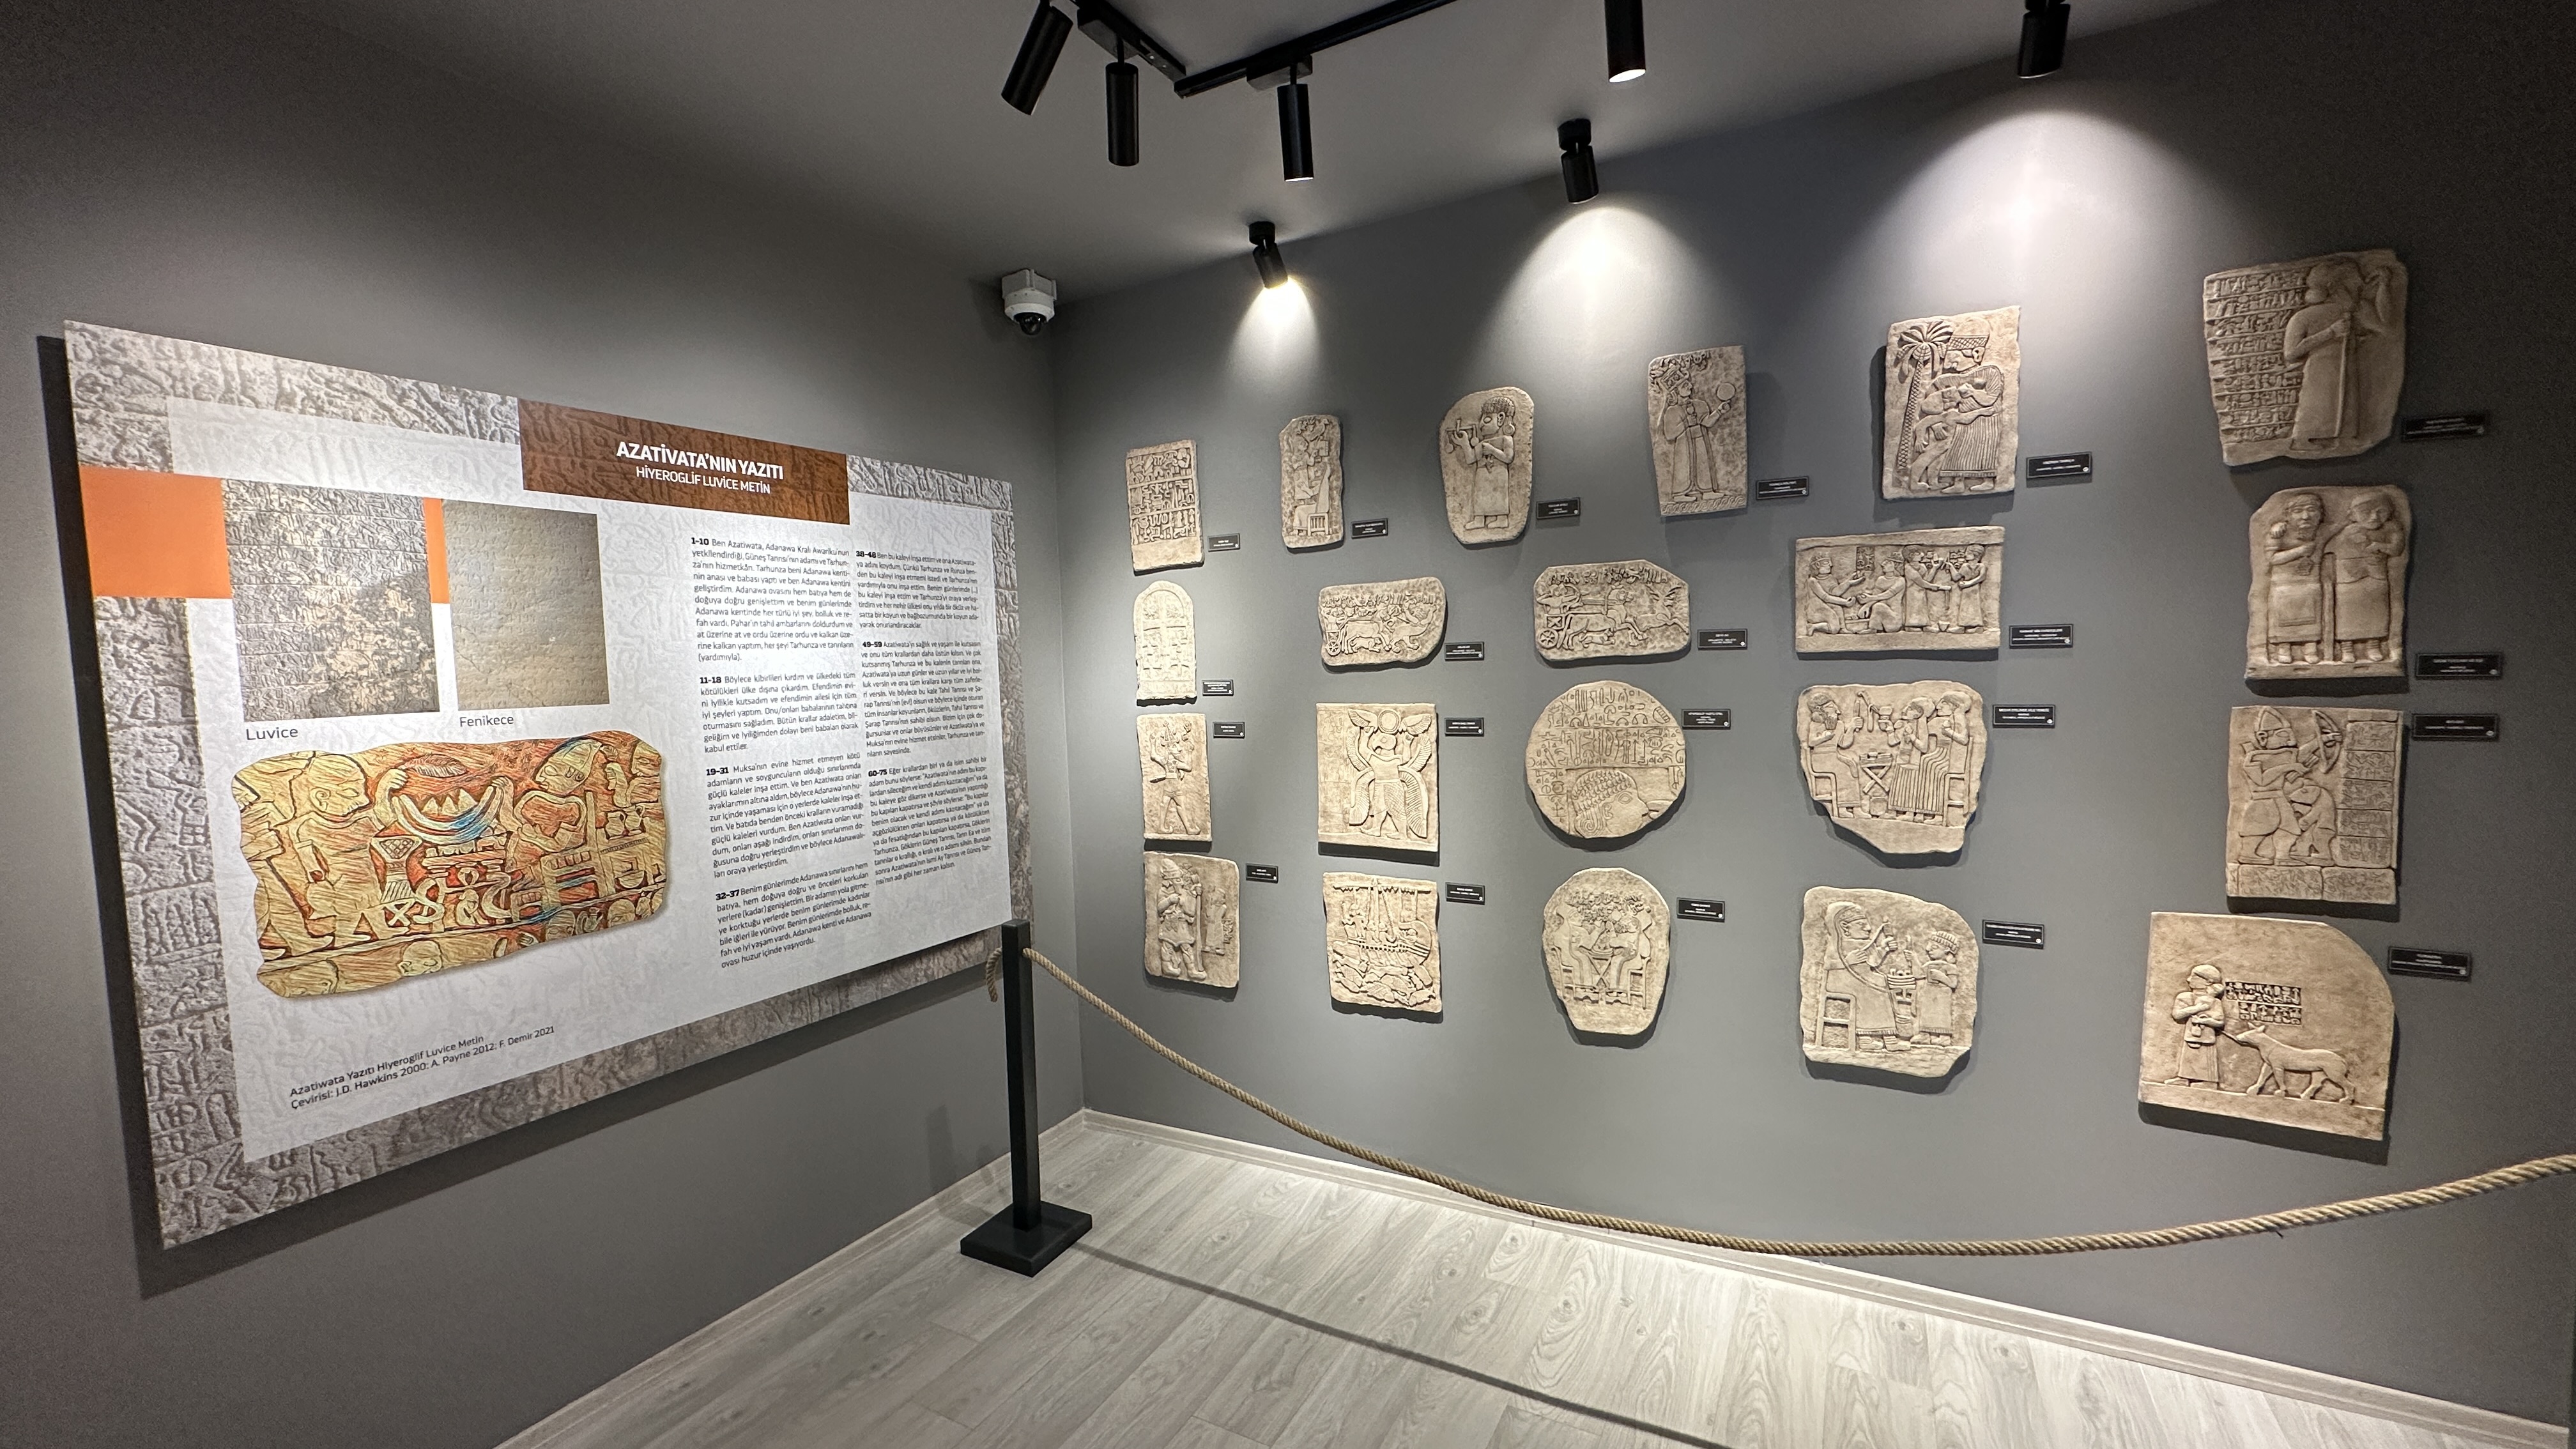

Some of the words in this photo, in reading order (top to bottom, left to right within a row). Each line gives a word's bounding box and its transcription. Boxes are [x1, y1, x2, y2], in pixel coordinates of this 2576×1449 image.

[617, 441, 736, 473] AZATİVATA'NIN
[737, 459, 784, 480] YAZITI
[636, 465, 701, 485] HİYEROGLİF
[703, 476, 739, 490] LUVİCE
[740, 480, 770, 494] METİN
[695, 596, 721, 605] doğuya
[701, 687, 738, 695] kötülükleri
[246, 726, 298, 740] Luvice
[459, 714, 514, 727] Fenikece
[706, 767, 729, 776] 19-31
[792, 758, 813, 766] hizmet
[708, 790, 727, 800] güçlü
[730, 787, 752, 795] kaleler
[814, 775, 843, 785] Azatiwata
[712, 834, 730, 846] güçlü
[733, 830, 757, 840] kaleleri
[760, 827, 786, 836] vurdum.
[802, 818, 832, 829] Azatiwata
[716, 889, 739, 900] 32-37
[740, 885, 762, 895] Benim
[763, 877, 799, 892] günlerimde
[800, 872, 827, 882] Adanawa
[761, 892, 785, 901] doğuya
[788, 887, 806, 896] doğru
[844, 873, 868, 883] korkulan
[721, 947, 732, 956] fah
[742, 942, 751, 952] iyi
[752, 939, 773, 950] yaşam
[793, 926, 821, 938] Adanawa
[822, 921, 837, 930] kenti
[846, 914, 871, 924] Adanawa
[721, 959, 739, 968] ovası
[741, 953, 761, 963] huzur
[762, 947, 782, 958] içinde
[290, 1076, 344, 1097] Azatiwata
[347, 1068, 374, 1080] Yazıtı
[378, 1051, 424, 1071] Hiyeroglif
[426, 1043, 456, 1057] Luvice
[459, 1036, 484, 1048] Metin
[355, 1071, 398, 1090] Hawkins
[443, 1051, 470, 1064] Payne
[508, 1033, 532, 1045] Demir
[535, 1026, 555, 1038] 2021
